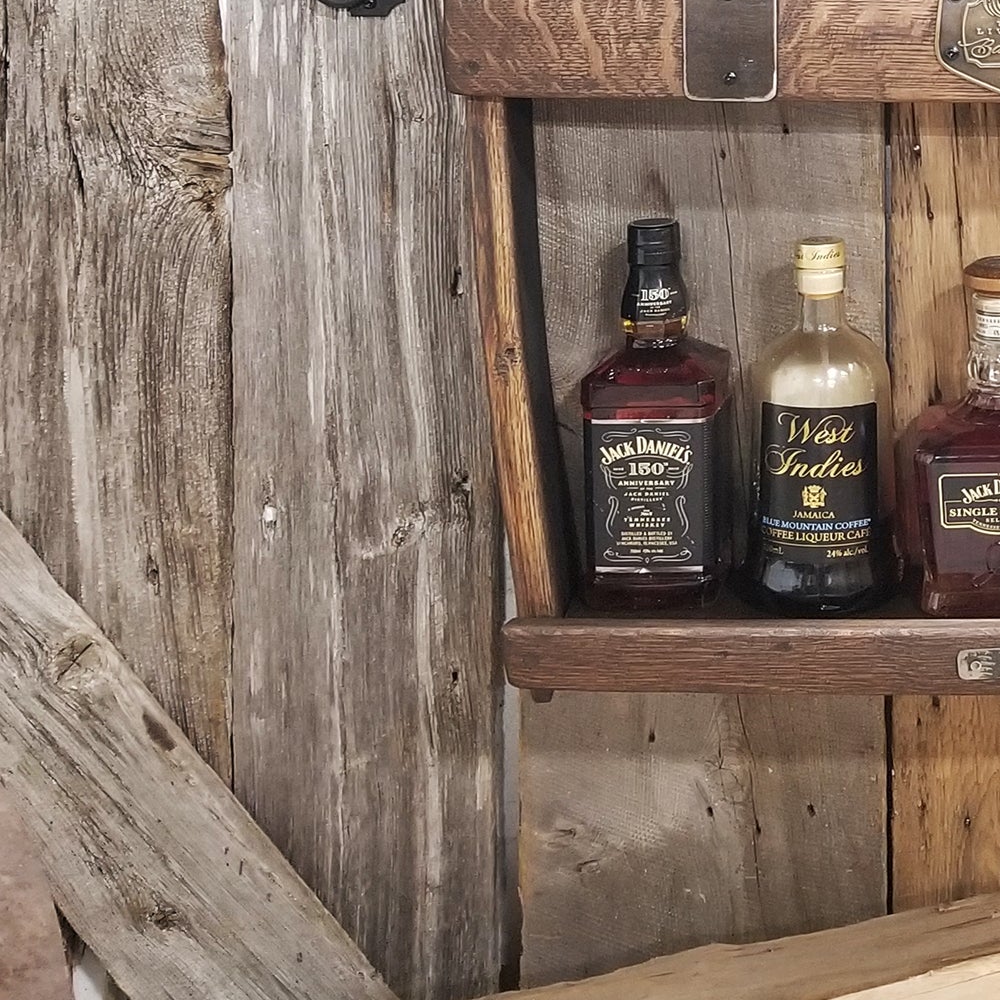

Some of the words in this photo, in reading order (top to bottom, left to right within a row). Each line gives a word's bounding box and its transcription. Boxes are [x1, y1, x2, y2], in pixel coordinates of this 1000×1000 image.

[640, 287, 669, 301] 150
[777, 412, 856, 445] West
[600, 441, 635, 466] JACK
[635, 436, 694, 466] DANIEL'S
[765, 444, 866, 478] Indies
[961, 482, 994, 504] JACK
[792, 510, 835, 519] JAMAICA
[949, 507, 998, 518] SINGLE
[762, 515, 781, 527] BLUE
[781, 520, 833, 531] MOUNTAIN
[834, 518, 871, 530] COFFEE
[795, 531, 846, 544] LIQUEUR
[826, 549, 842, 558] 24%
